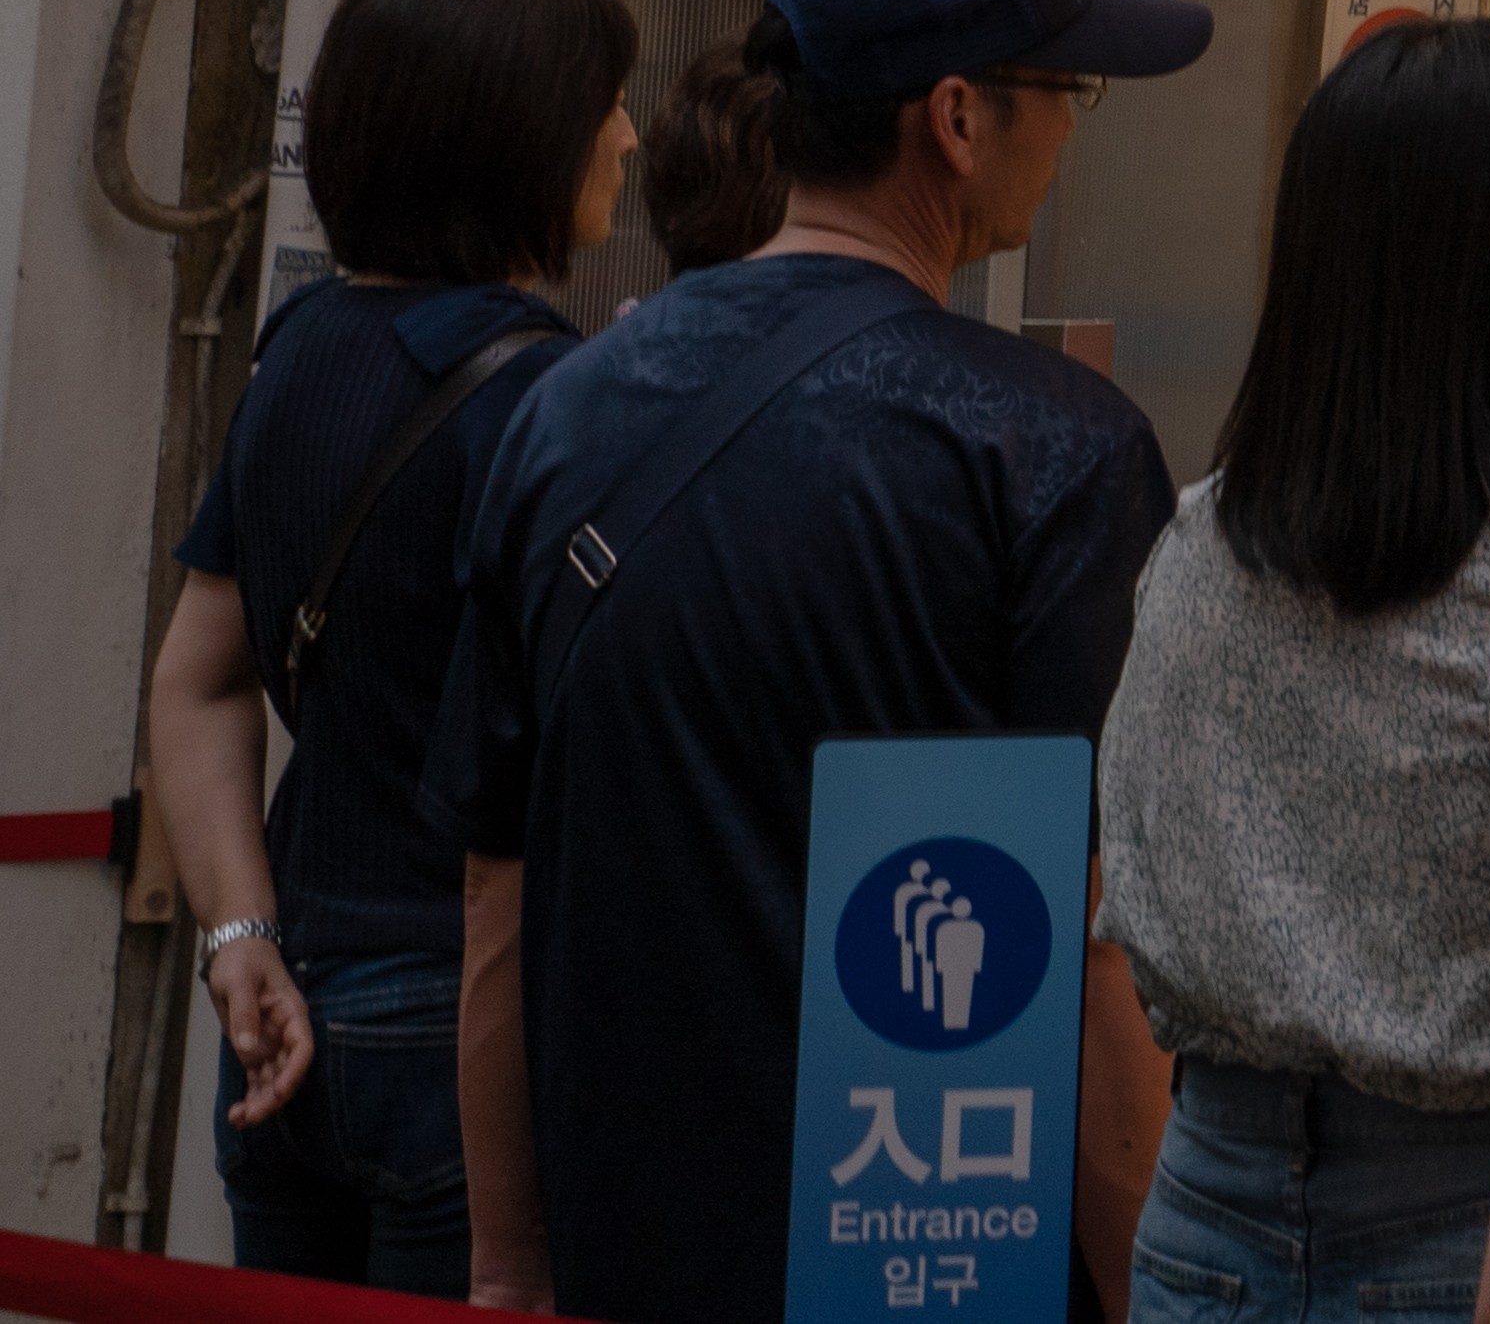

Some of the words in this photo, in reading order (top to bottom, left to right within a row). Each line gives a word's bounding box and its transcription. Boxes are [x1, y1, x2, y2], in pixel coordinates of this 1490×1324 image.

[830, 1087, 1034, 1188] 入口
[830, 1200, 1038, 1244] Entrance
[885, 1253, 979, 1308] 입구
